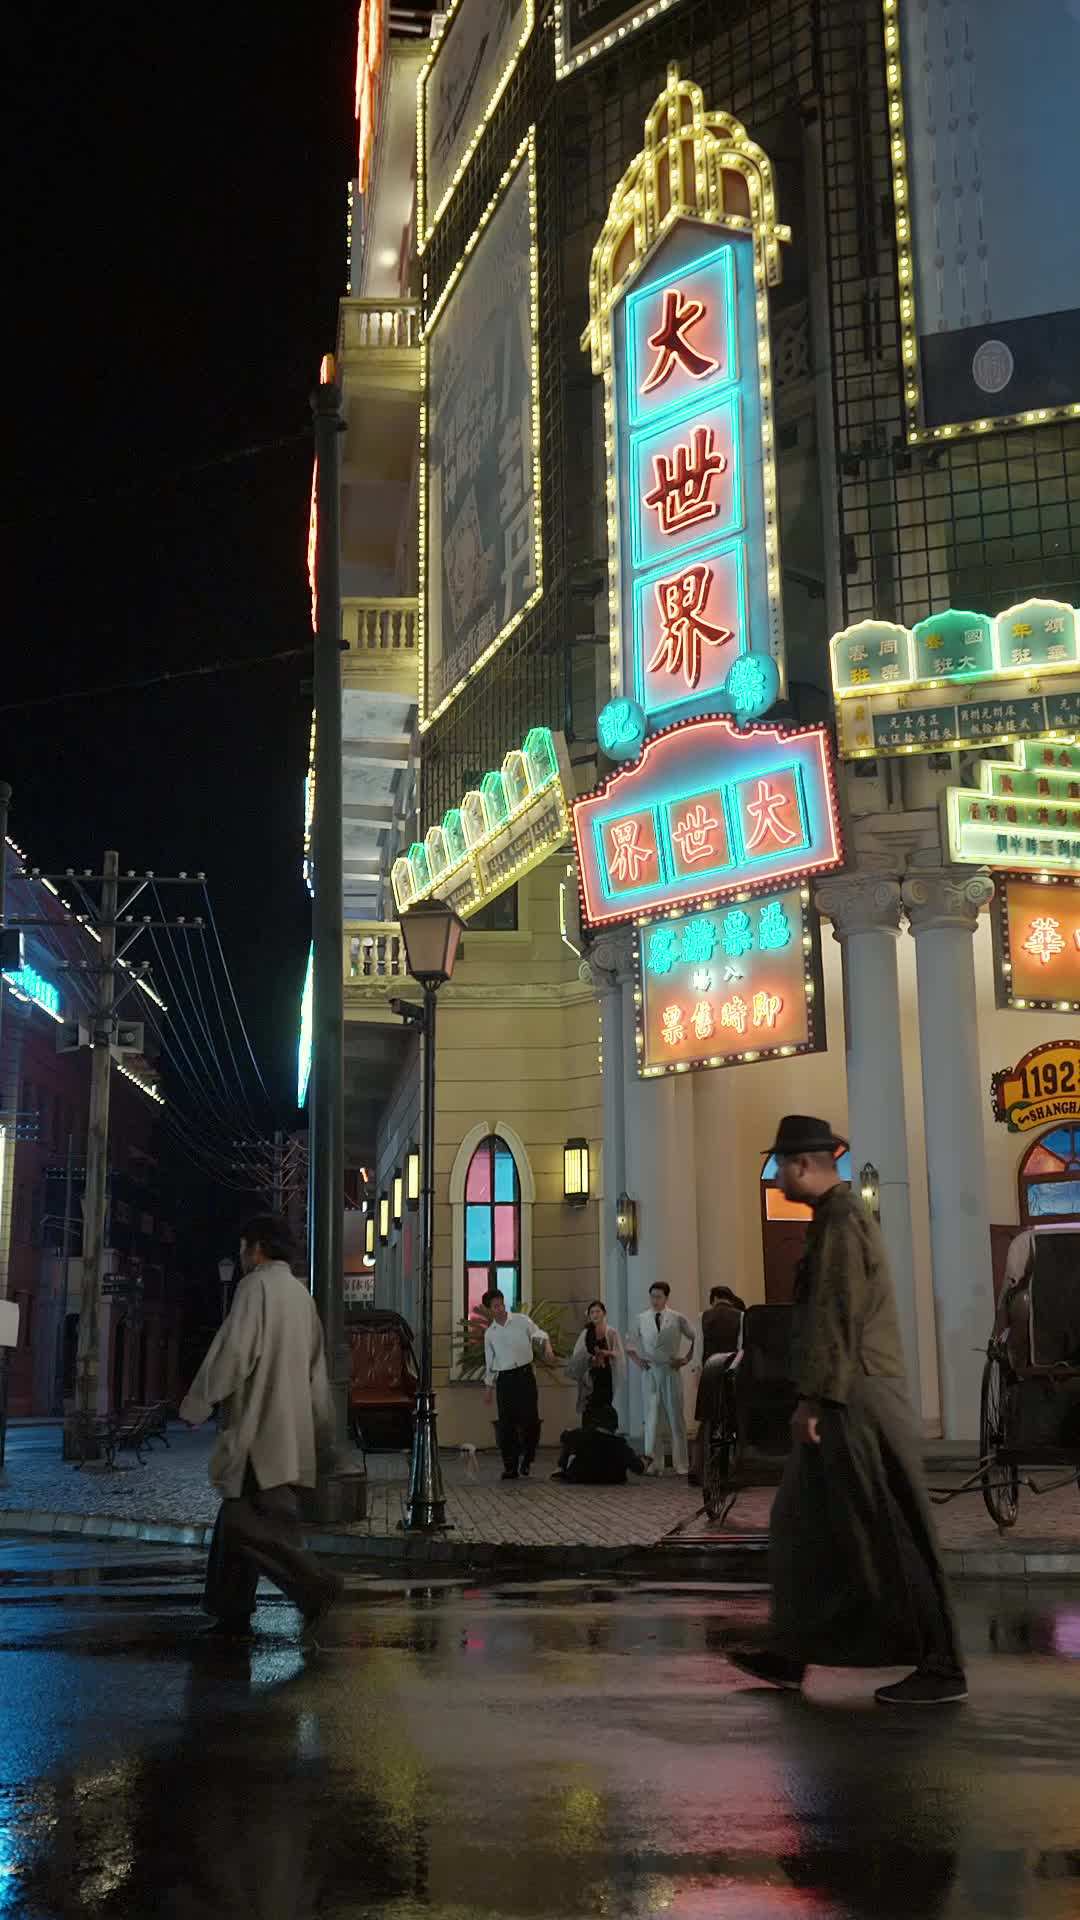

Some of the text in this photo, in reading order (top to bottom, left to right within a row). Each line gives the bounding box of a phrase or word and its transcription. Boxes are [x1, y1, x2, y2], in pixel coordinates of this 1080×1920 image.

[639, 288, 733, 689] 大世界
[609, 780, 797, 881] 大世界
[1028, 1101, 1080, 1122] SHANGH
